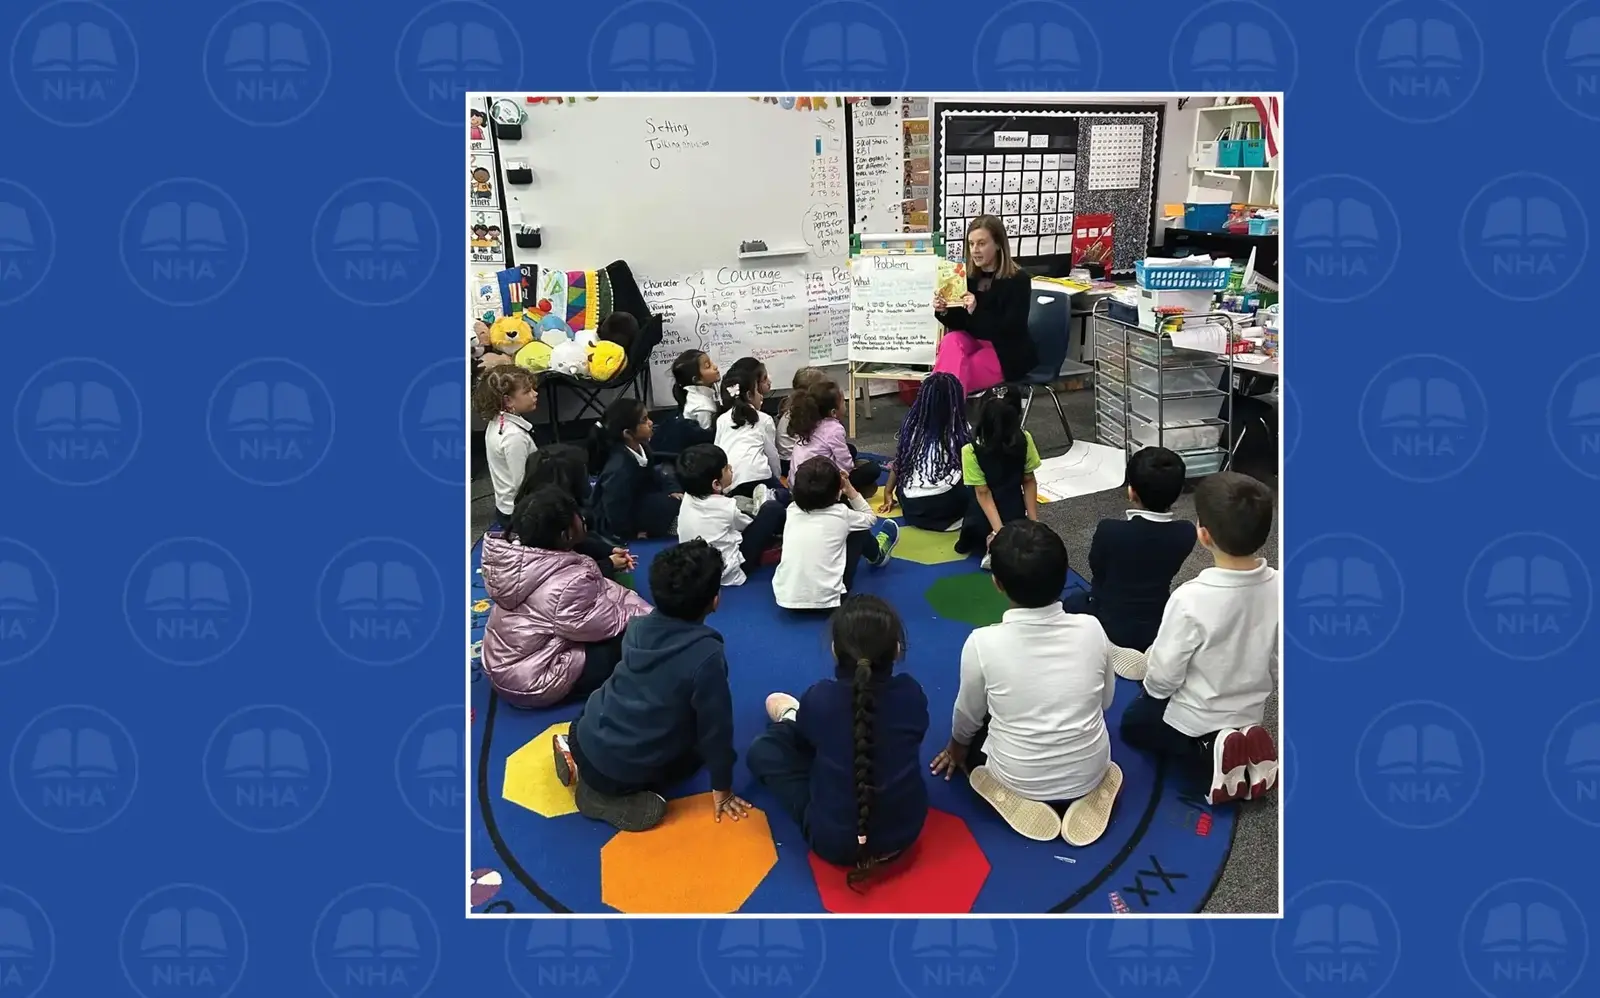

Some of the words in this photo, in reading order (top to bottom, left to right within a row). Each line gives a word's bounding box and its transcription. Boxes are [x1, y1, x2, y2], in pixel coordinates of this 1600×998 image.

[645, 117, 689, 138] Setting
[1002, 135, 1025, 143] February
[649, 157, 661, 170] O
[476, 212, 485, 225] 3
[472, 253, 494, 263] groups
[873, 255, 910, 270] Problem
[716, 266, 782, 286] Courage
[832, 265, 852, 281] Pers
[643, 279, 680, 290] Character
[852, 277, 871, 287] What
